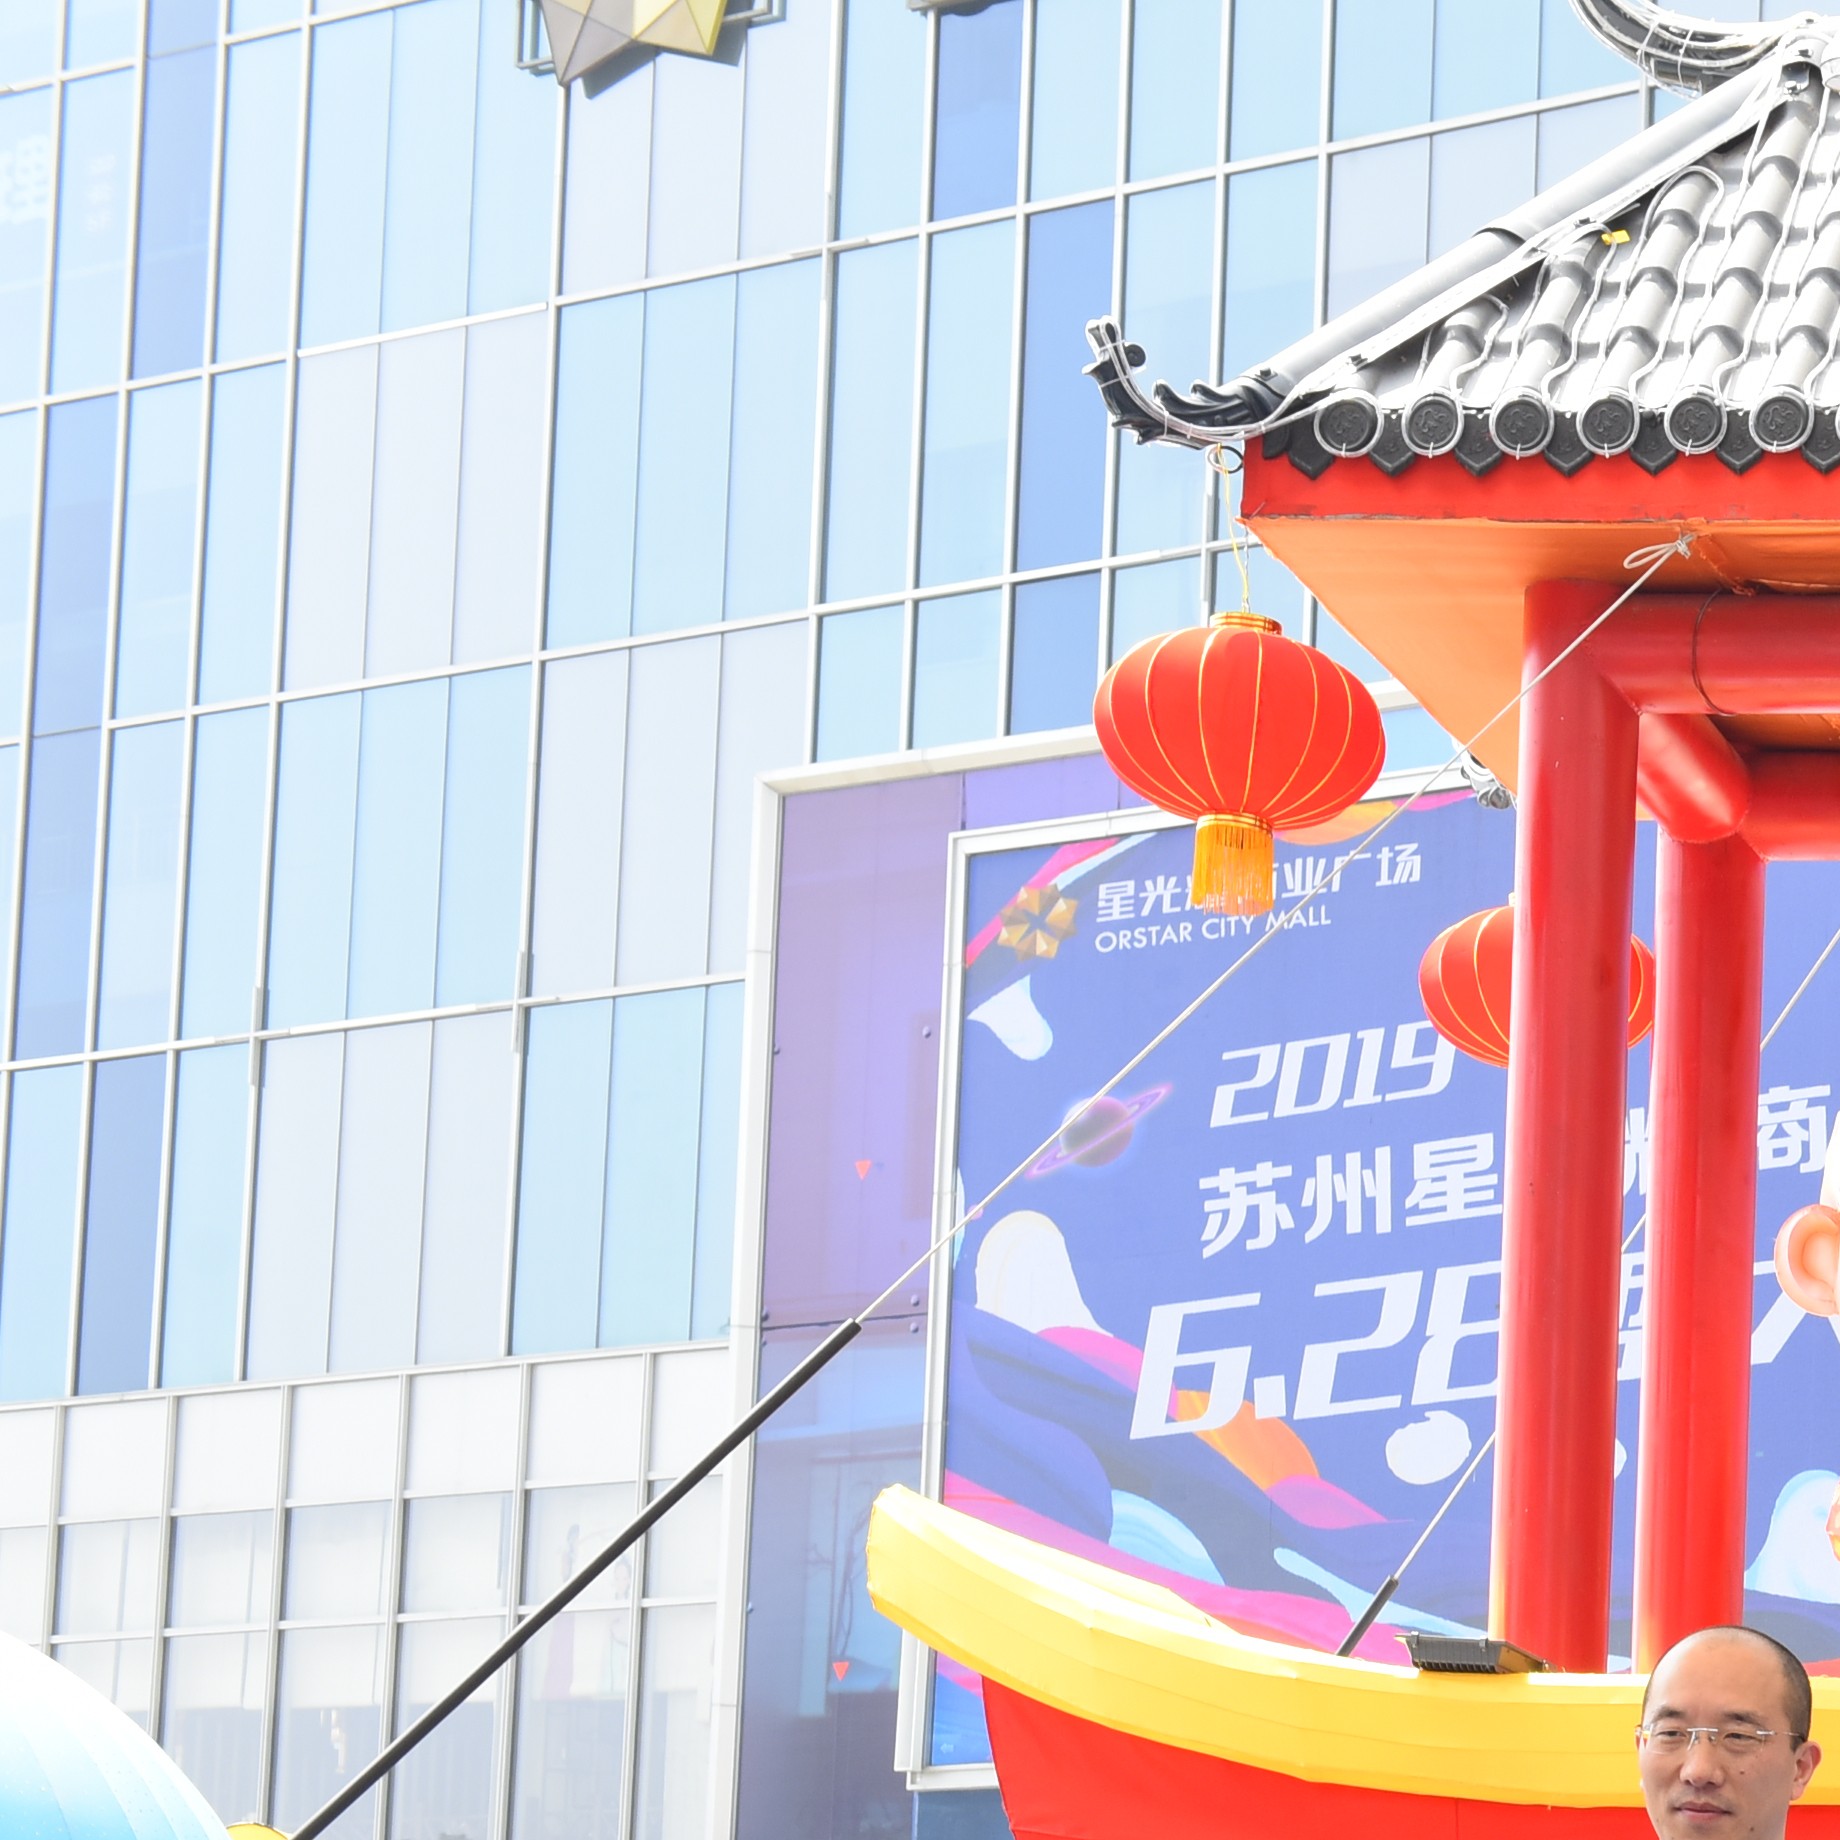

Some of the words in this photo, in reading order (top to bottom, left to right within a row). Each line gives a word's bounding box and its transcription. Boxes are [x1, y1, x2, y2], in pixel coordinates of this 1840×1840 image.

[1096, 843, 1421, 922] 星光业广场
[1094, 923, 1192, 953] ORSTAR
[1202, 914, 1257, 941] CITY
[1265, 905, 1331, 932] MALL
[1210, 1019, 1456, 1128] 2019
